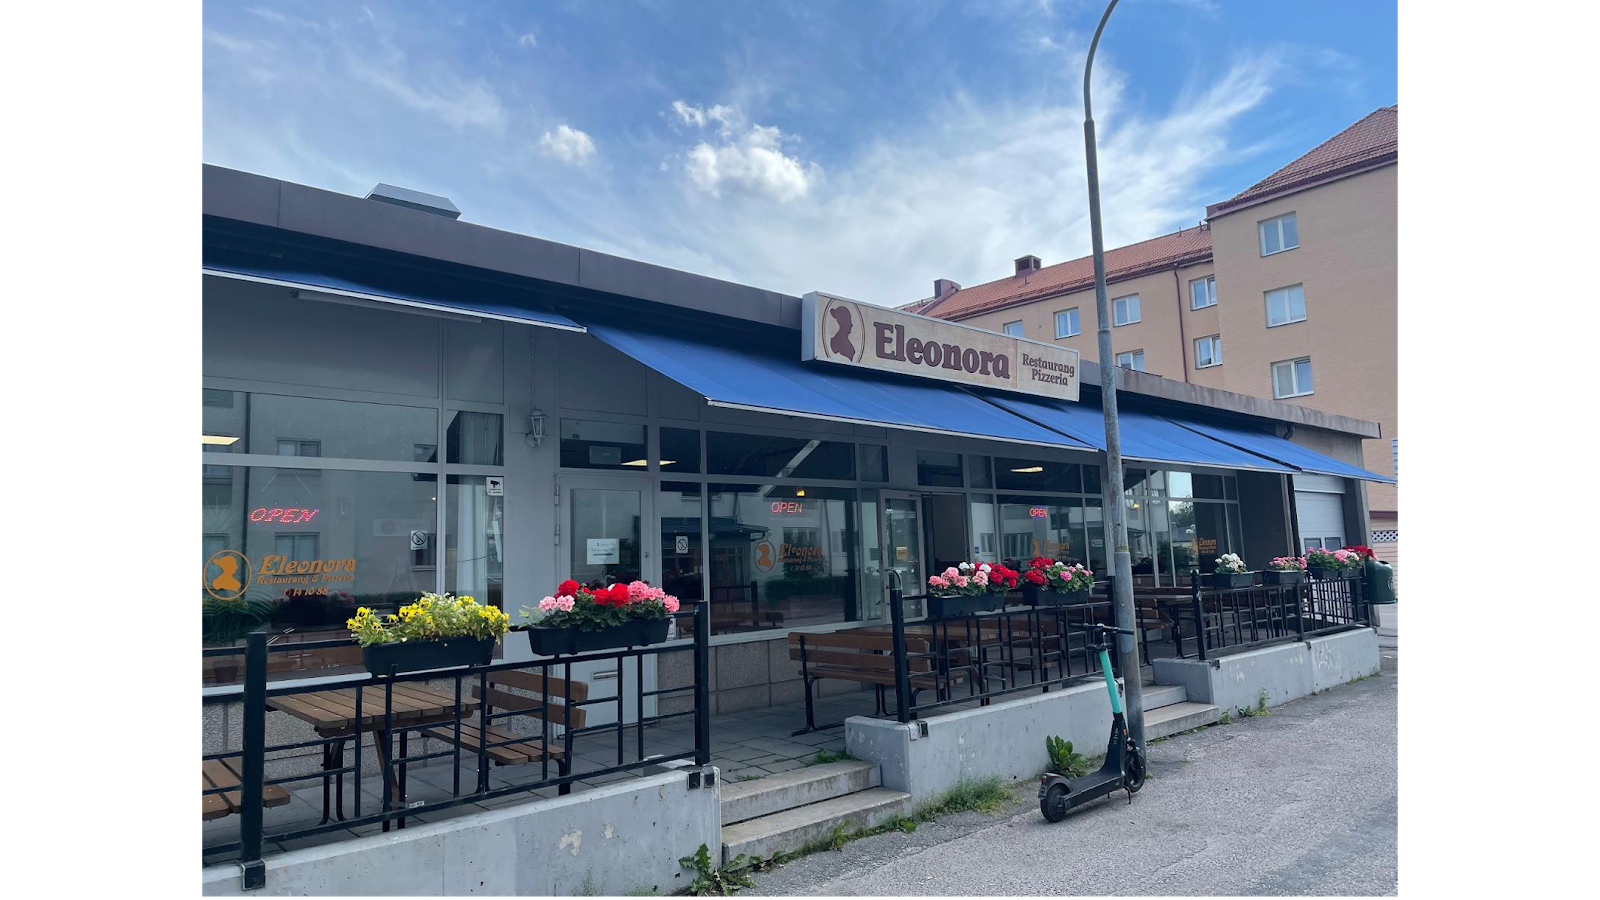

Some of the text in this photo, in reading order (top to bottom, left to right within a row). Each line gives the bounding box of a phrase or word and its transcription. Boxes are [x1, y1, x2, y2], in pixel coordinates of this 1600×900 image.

[873, 321, 1010, 380] Eleonora
[1022, 353, 1075, 378] Restaurang
[1031, 368, 1068, 386] Pizzeria
[250, 507, 320, 523] OPEN
[771, 502, 803, 513] OPEN
[1029, 507, 1048, 518] OPEN
[258, 554, 357, 575] Eleonora
[256, 575, 309, 584] Restaurang
